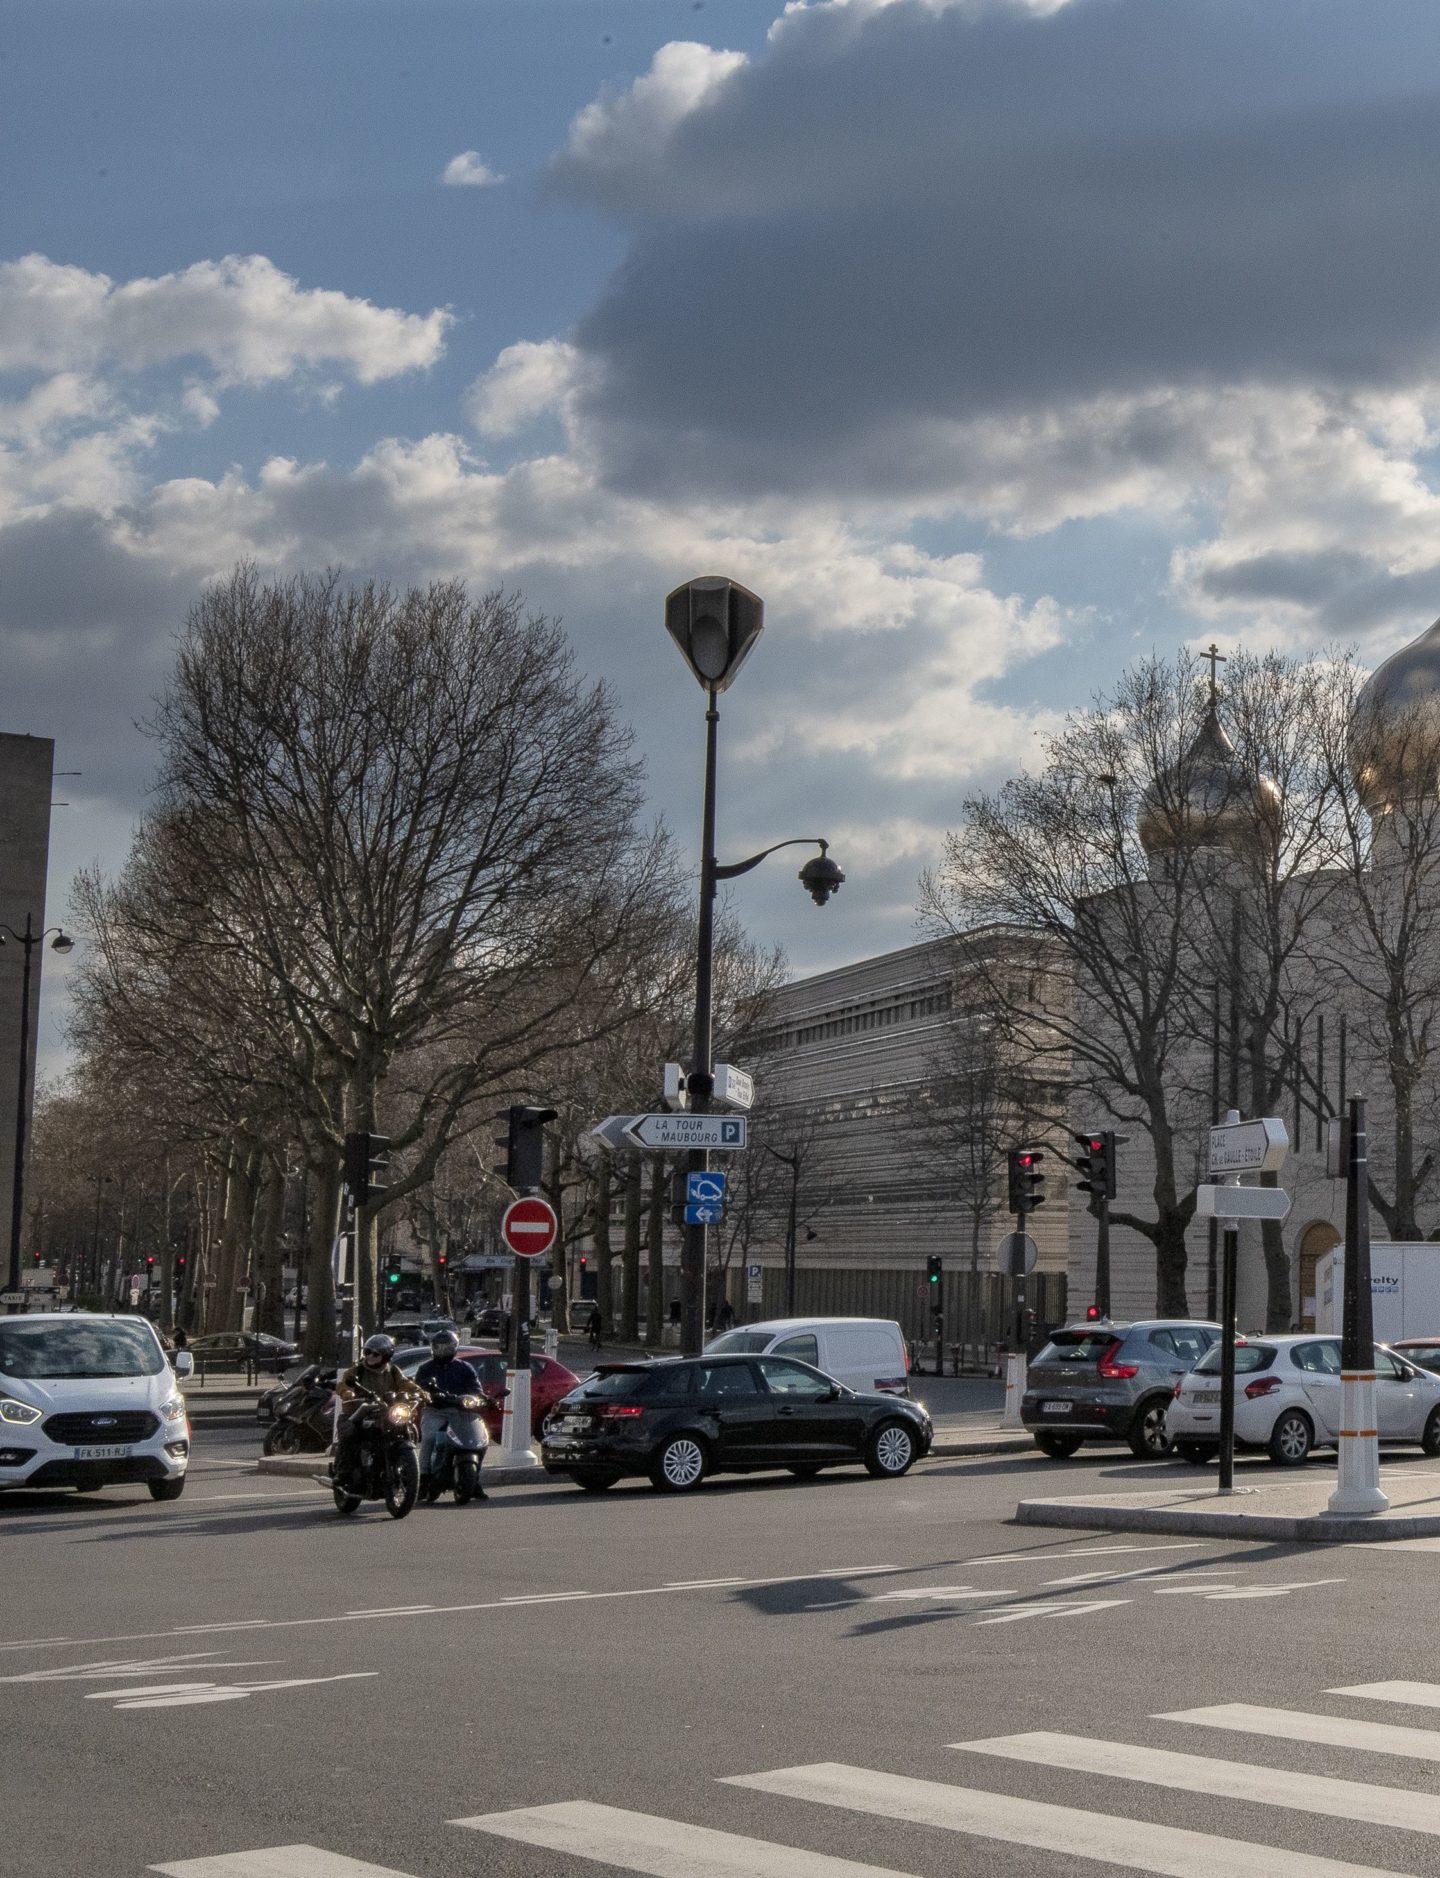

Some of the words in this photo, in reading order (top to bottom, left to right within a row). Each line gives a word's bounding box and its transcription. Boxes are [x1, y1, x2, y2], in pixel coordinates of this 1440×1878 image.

[655, 1120, 668, 1130] LA
[675, 1120, 703, 1130] TOUR
[1211, 1134, 1226, 1149] PLACE
[1370, 1276, 1399, 1286] elty
